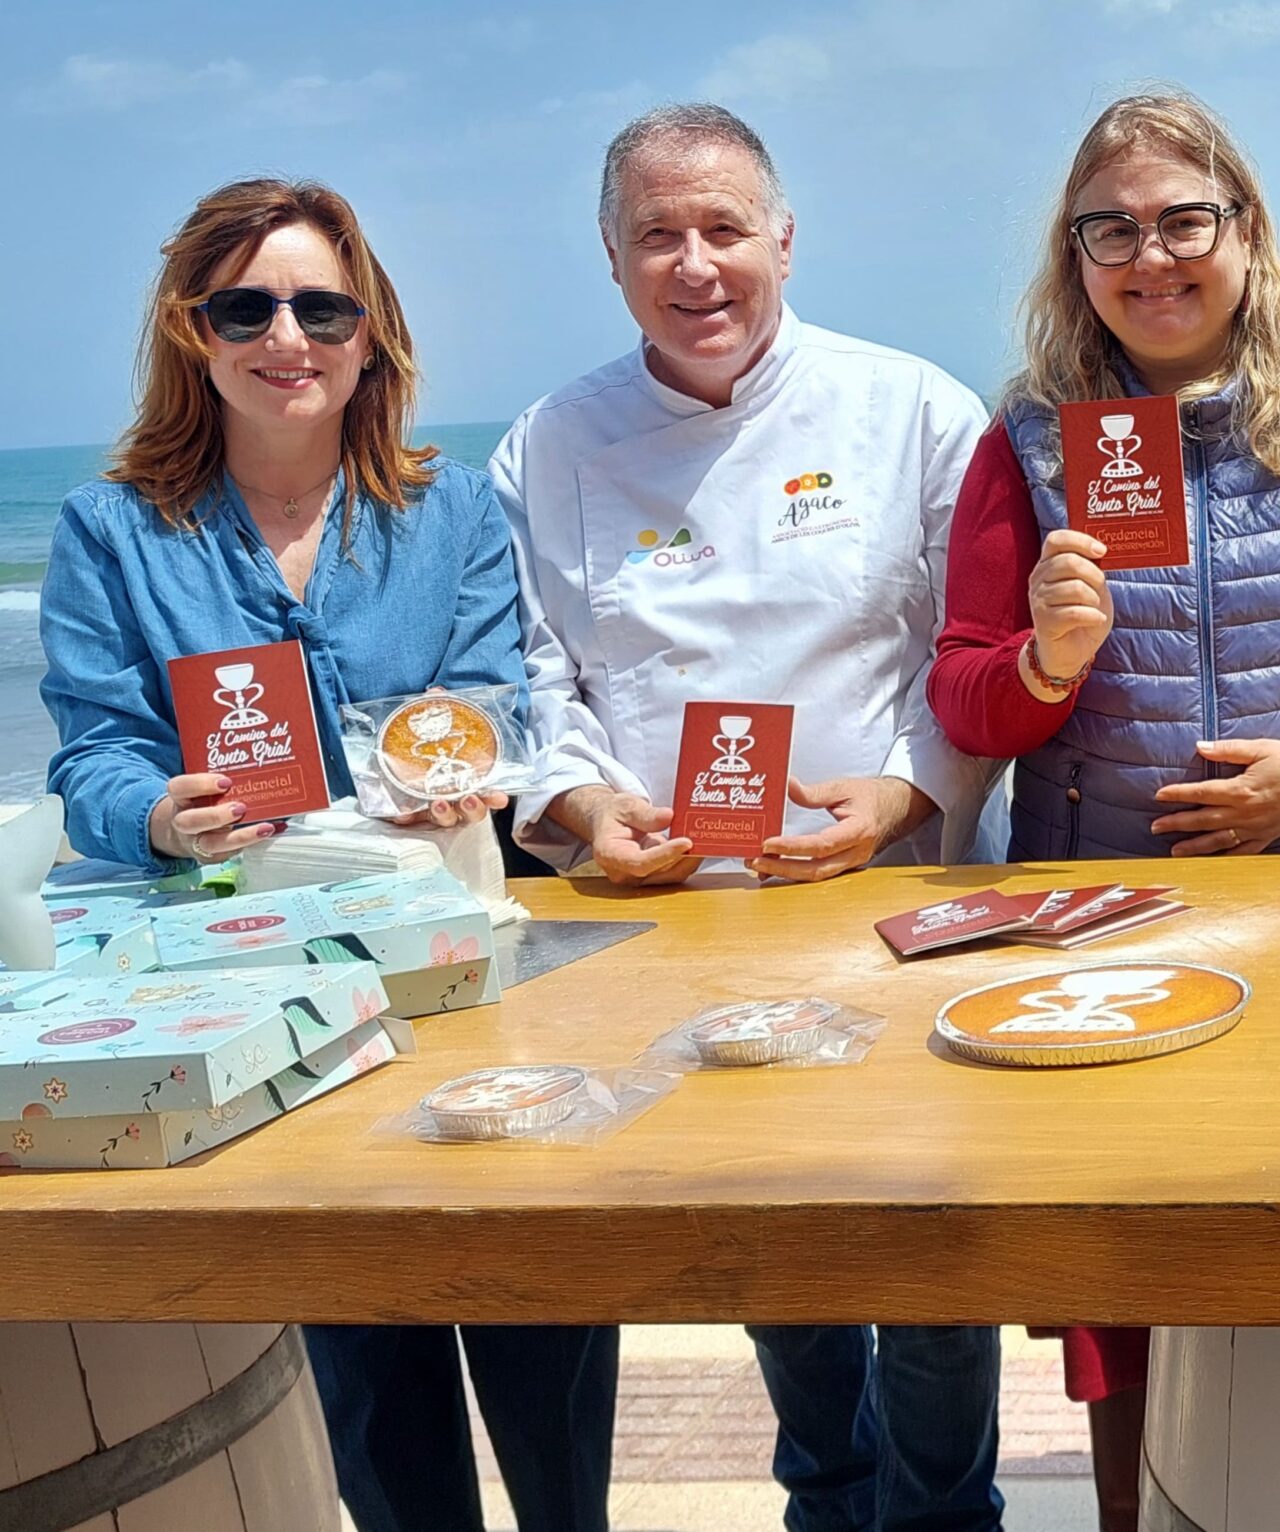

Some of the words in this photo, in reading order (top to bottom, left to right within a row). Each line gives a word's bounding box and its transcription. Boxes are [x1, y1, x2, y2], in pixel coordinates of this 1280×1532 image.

[1088, 479, 1100, 495] El
[1103, 479, 1141, 494] Camino
[1143, 475, 1159, 490] del
[777, 494, 848, 527] Agaco
[1087, 494, 1124, 514] Santo
[1126, 489, 1162, 517] Grial
[1096, 527, 1159, 543] Credencial
[653, 545, 716, 567] Oliva
[206, 732, 222, 750] El
[224, 729, 268, 746] Camino
[270, 721, 289, 738] del
[207, 747, 250, 770] Santo
[252, 735, 291, 767] Grial
[695, 772, 708, 785] El
[709, 773, 746, 786] Camino
[749, 774, 767, 787] del
[690, 786, 728, 803] Santo
[729, 786, 766, 809] Grial
[694, 817, 755, 832] Credencial
